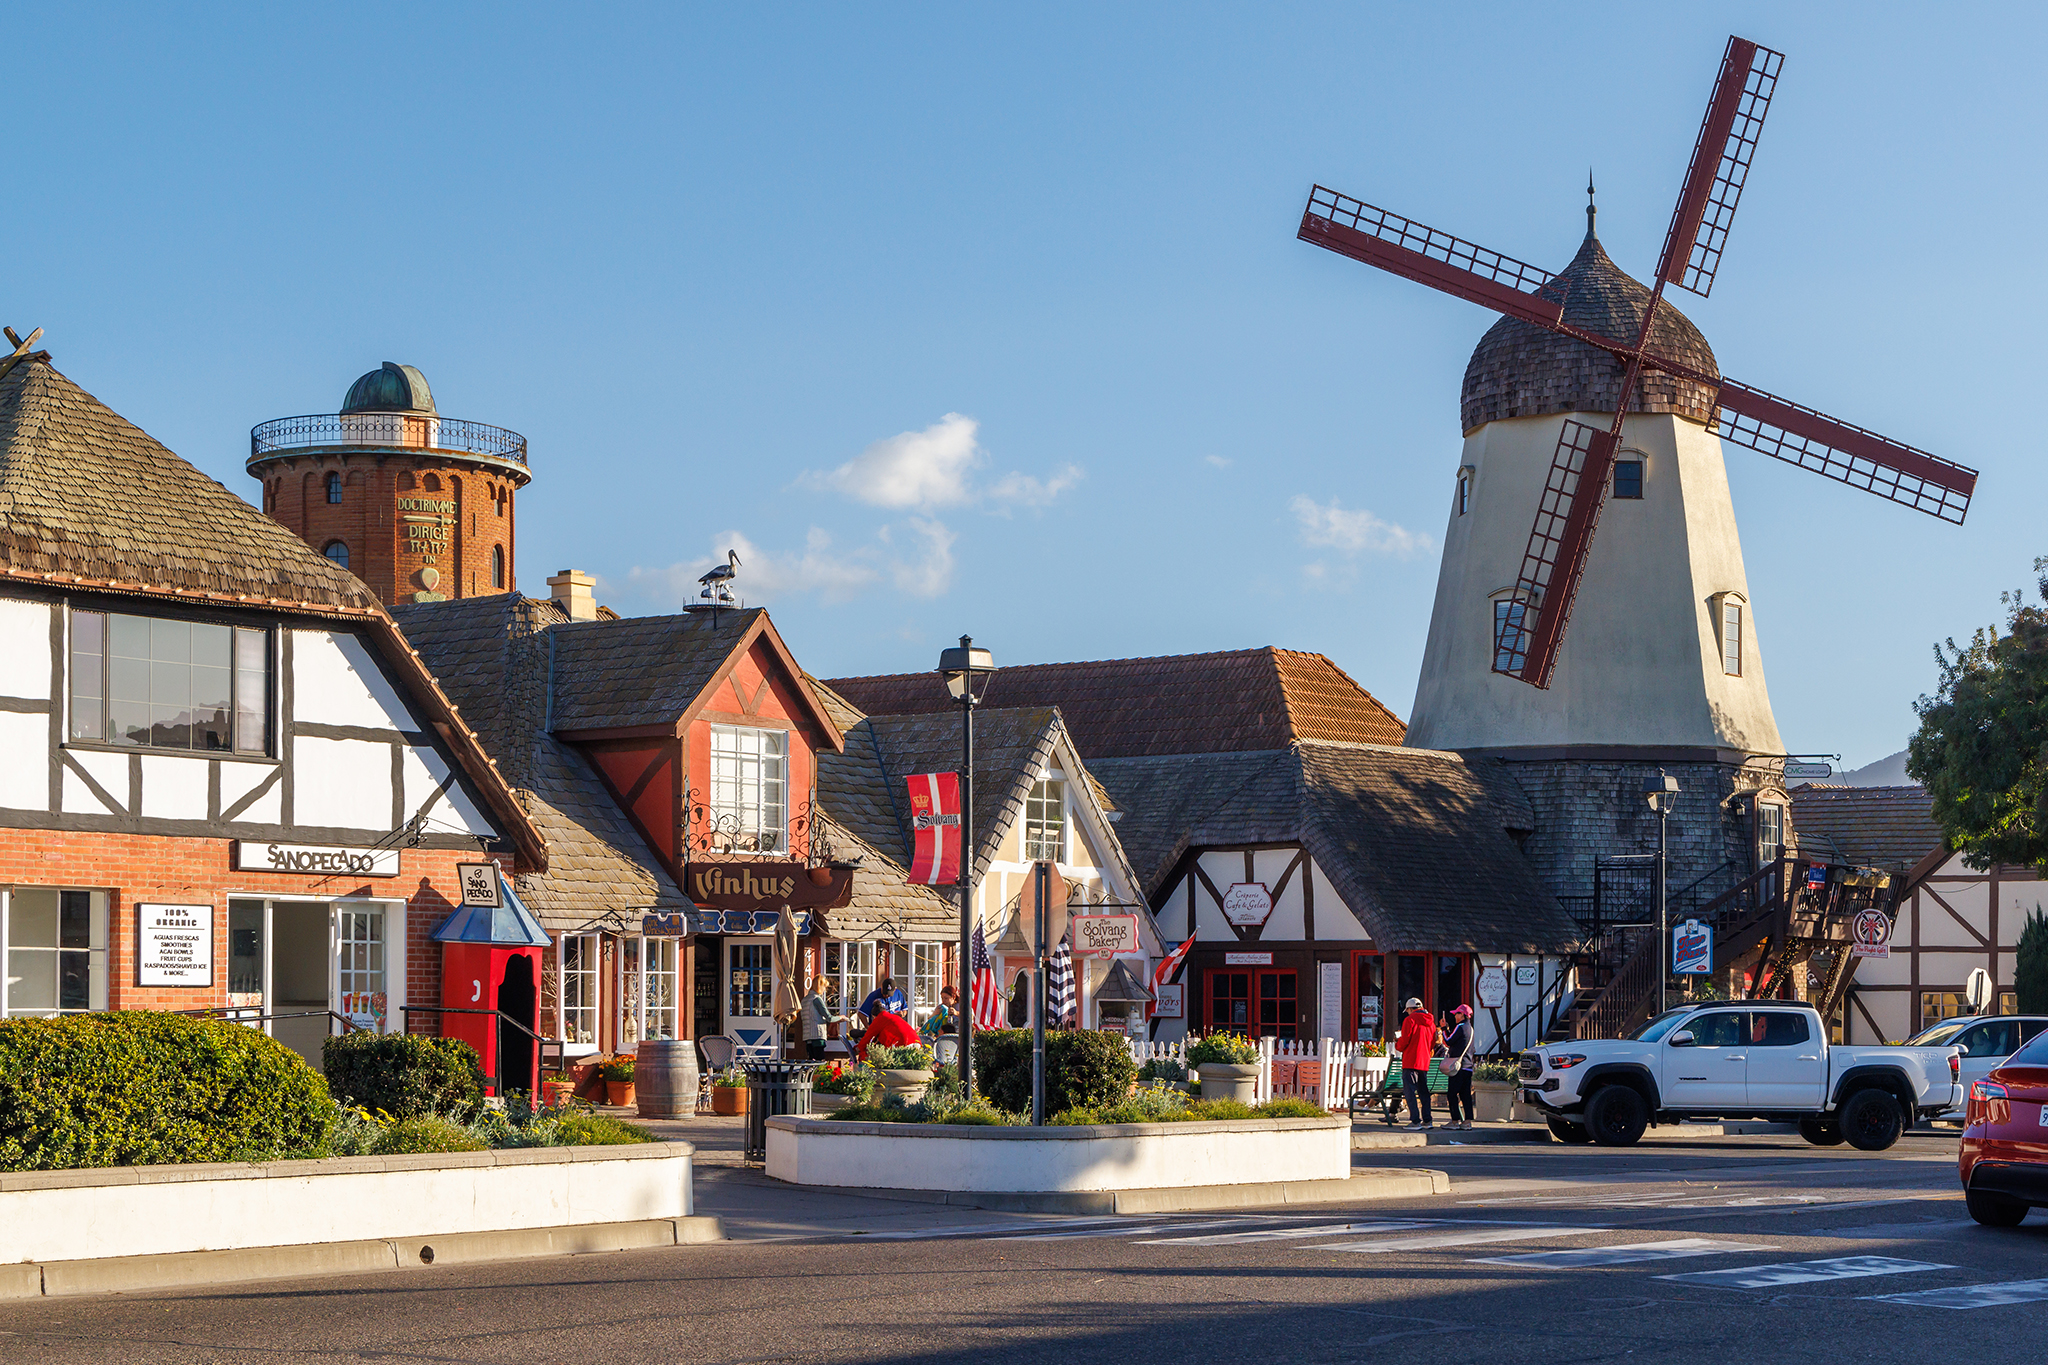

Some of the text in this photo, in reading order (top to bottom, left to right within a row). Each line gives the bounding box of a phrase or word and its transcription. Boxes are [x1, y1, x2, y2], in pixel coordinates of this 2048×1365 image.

[409, 525, 449, 540] DIRIGE
[425, 555, 436, 564] IN
[916, 810, 960, 830] Solvang
[267, 843, 374, 872] SANOPECADO
[467, 876, 488, 888] SANO
[695, 867, 796, 900] Vinhus
[466, 888, 494, 898] PECADO
[1246, 898, 1269, 910] Gelato
[164, 908, 189, 916] 100%
[156, 918, 197, 926] ORGANIC
[1082, 921, 1128, 940] Solvang
[1089, 935, 1121, 949] Bakery
[1678, 935, 1706, 949] Tower
[1677, 948, 1707, 962] Pizza
[804, 948, 813, 990] 440
